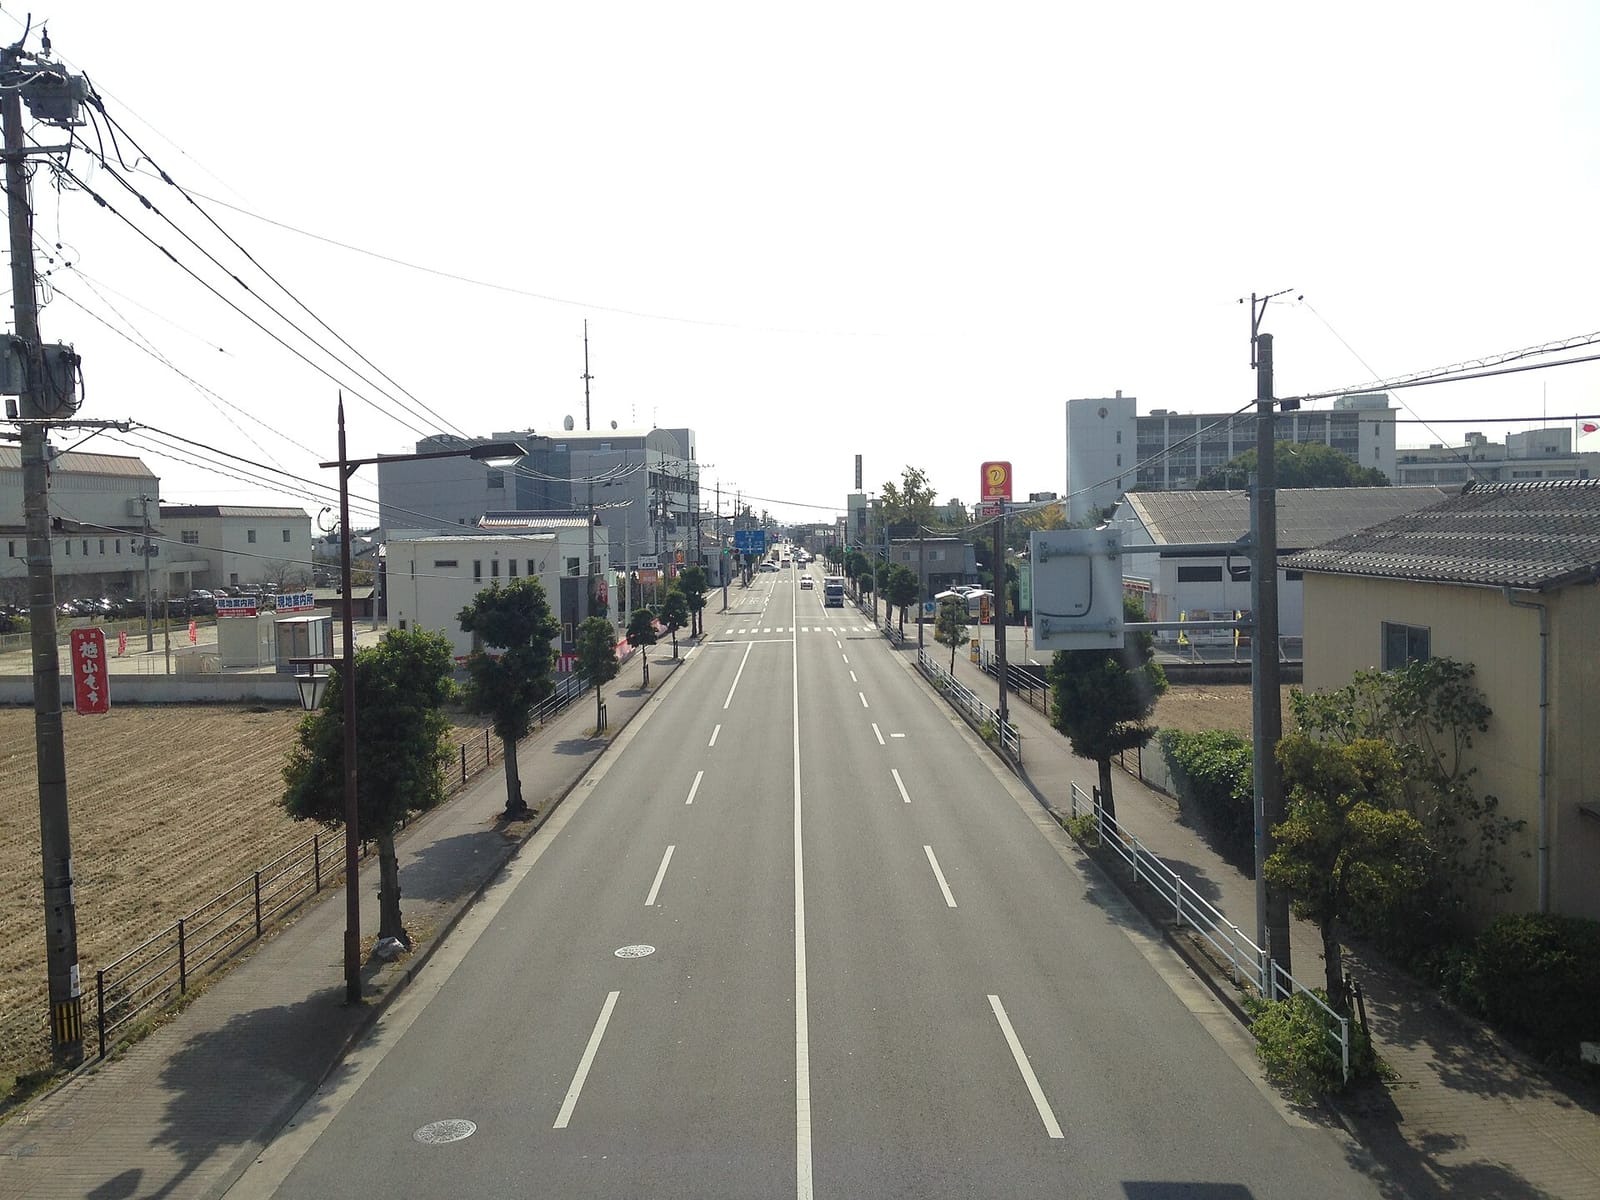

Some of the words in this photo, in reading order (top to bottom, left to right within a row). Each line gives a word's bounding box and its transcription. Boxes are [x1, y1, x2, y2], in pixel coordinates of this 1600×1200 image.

[218, 599, 255, 608] 現地案内所
[276, 593, 314, 608] 現地案内所
